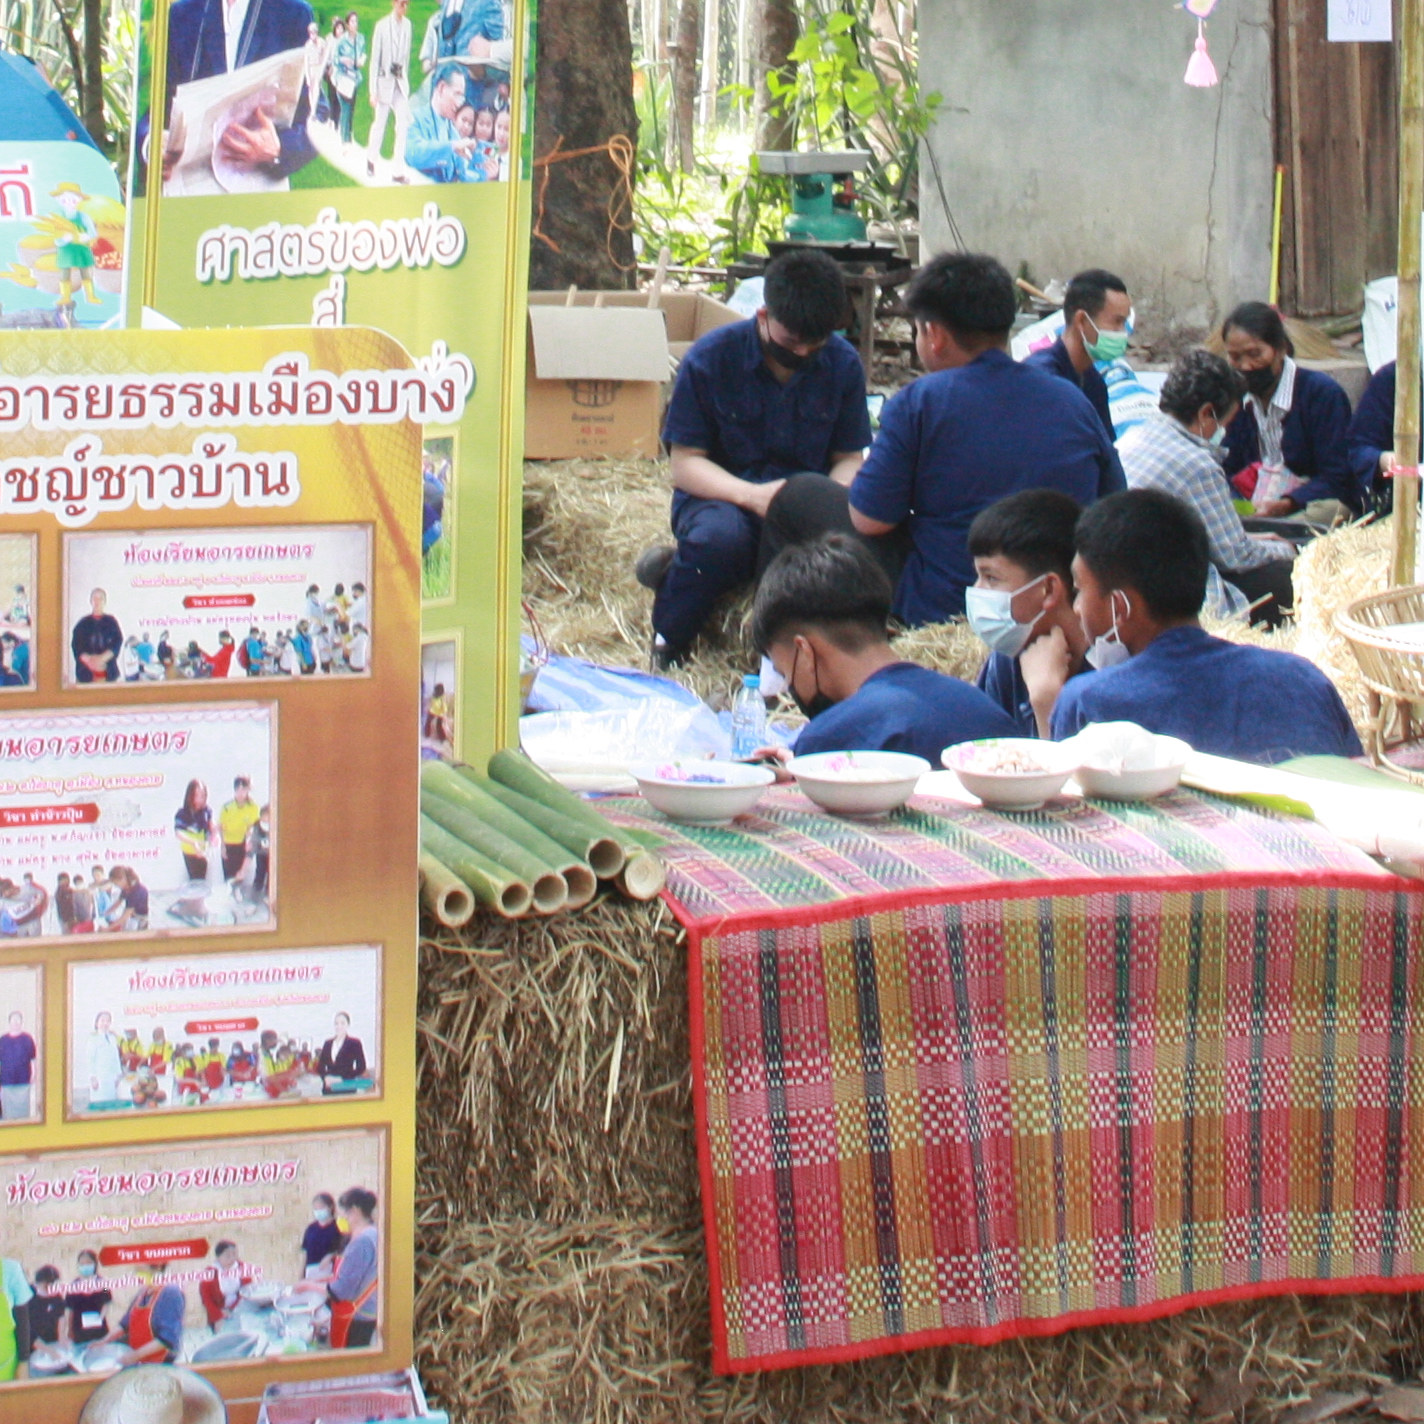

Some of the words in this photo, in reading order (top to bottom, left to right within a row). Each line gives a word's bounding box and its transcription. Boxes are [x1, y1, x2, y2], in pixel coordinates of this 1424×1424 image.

[202, 206, 460, 274] ศาสตร์ของพ่อ
[6, 1159, 299, 1205] ห้องเรียนอารยเกษตร
